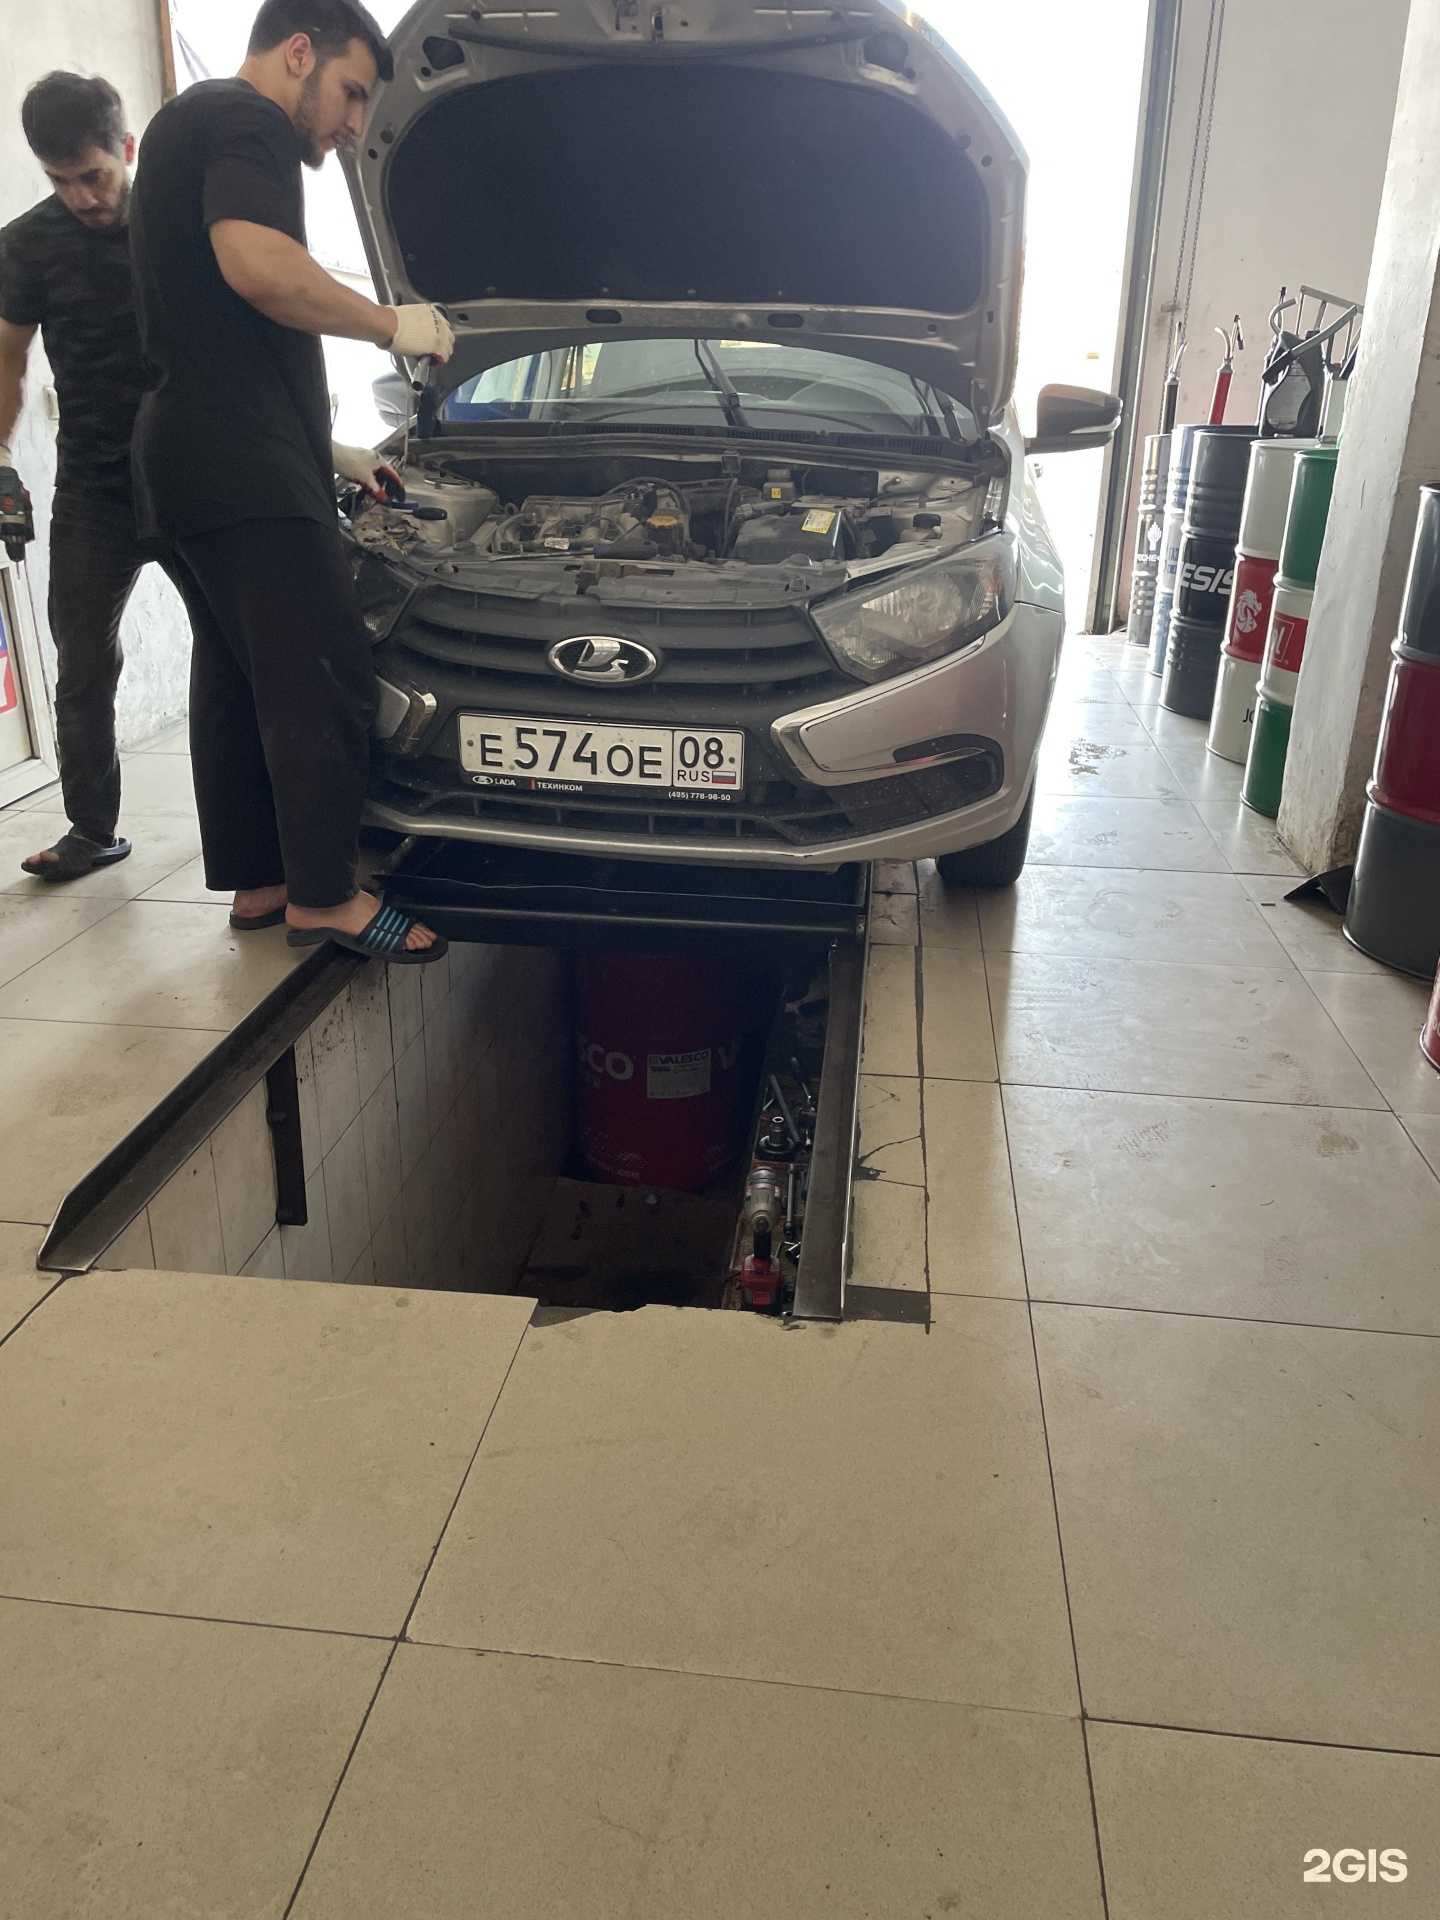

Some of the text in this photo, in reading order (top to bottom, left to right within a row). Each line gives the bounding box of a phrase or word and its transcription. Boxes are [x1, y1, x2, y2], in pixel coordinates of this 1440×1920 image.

[479, 726, 663, 779] Е574ОЕ
[679, 735, 724, 769] 08
[494, 777, 517, 787] LADA
[677, 769, 711, 783] RUS
[537, 781, 584, 792] ТЕХИНКОМ
[657, 1050, 708, 1065] VALESCO
